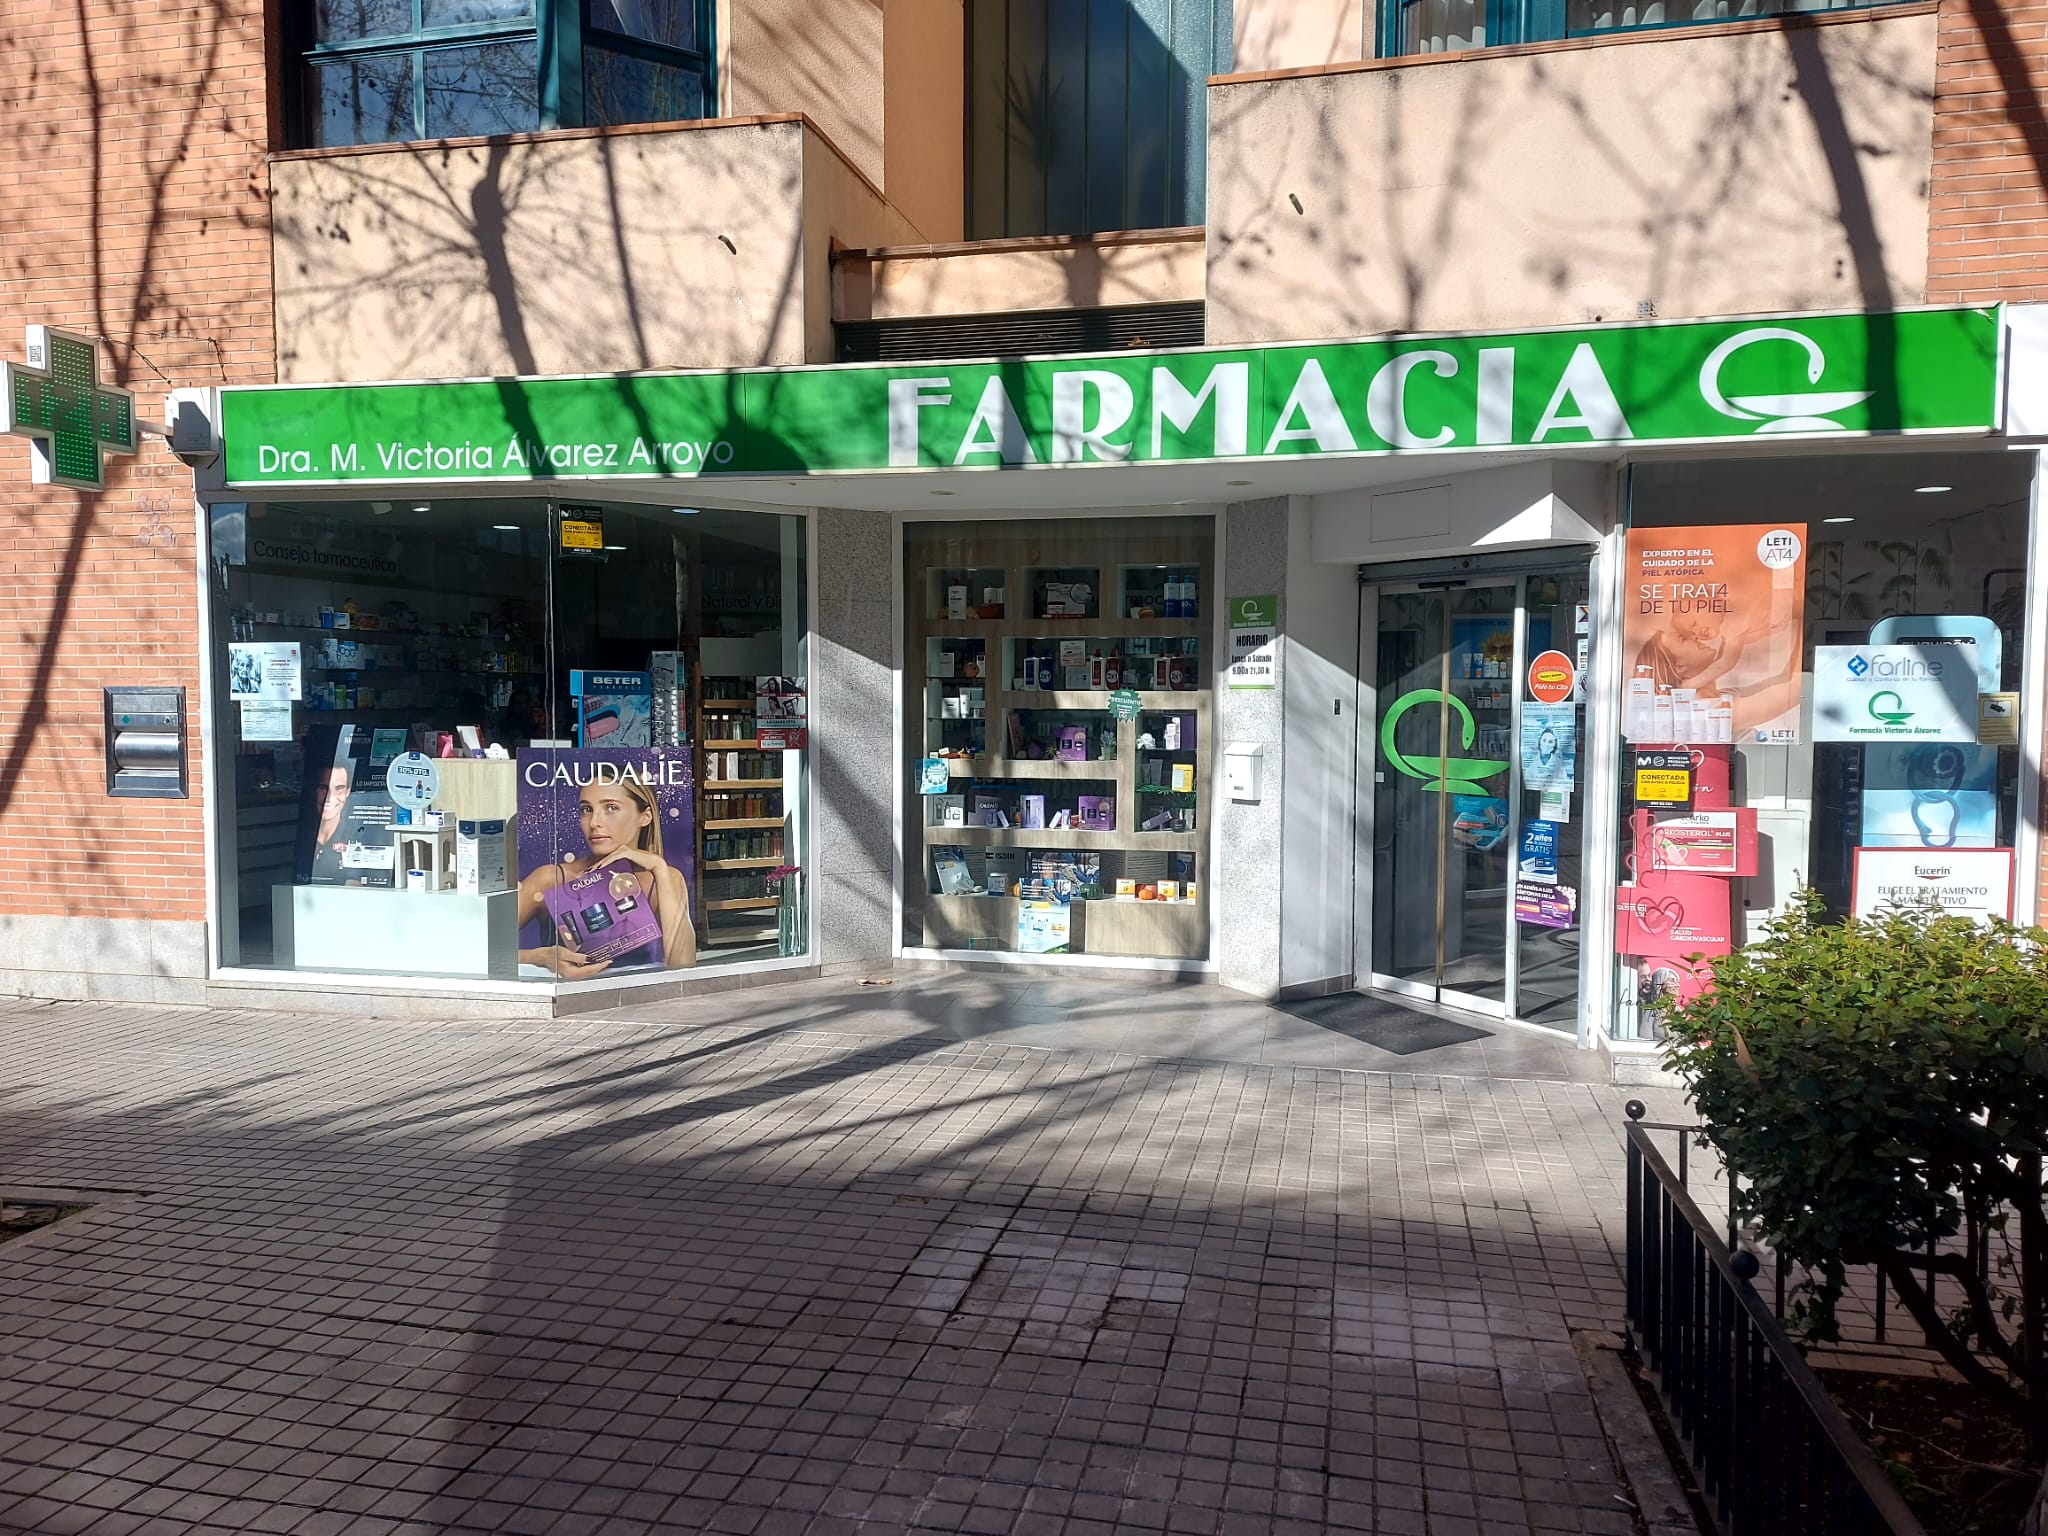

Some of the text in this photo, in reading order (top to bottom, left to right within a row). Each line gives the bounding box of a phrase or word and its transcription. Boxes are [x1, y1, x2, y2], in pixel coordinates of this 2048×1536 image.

[887, 342, 1636, 468] FARMACIA
[259, 431, 734, 476] Dra. M. Victoria Álvarez Arroyo
[1766, 537, 1792, 546] LETI
[254, 540, 310, 564] Consejo
[1642, 549, 1714, 558] EXPERTO EN EL
[1764, 549, 1794, 562] AT4
[1642, 559, 1685, 567] CUIDADO
[1701, 558, 1714, 566] LA
[1642, 567, 1705, 577] PIEL ATÓPICA
[1639, 584, 1664, 600] SE
[1640, 599, 1733, 614] DE TU PIEL
[1236, 634, 1268, 647] HORARIO
[1871, 654, 1944, 677] farline
[592, 676, 642, 685] BETER
[1771, 729, 1795, 738] LETI
[1849, 725, 1942, 734] Farmacia Victoria Álvarez
[1689, 813, 1710, 822] Arko
[1525, 833, 1534, 844] 2
[1914, 865, 1951, 876] Eucerin
